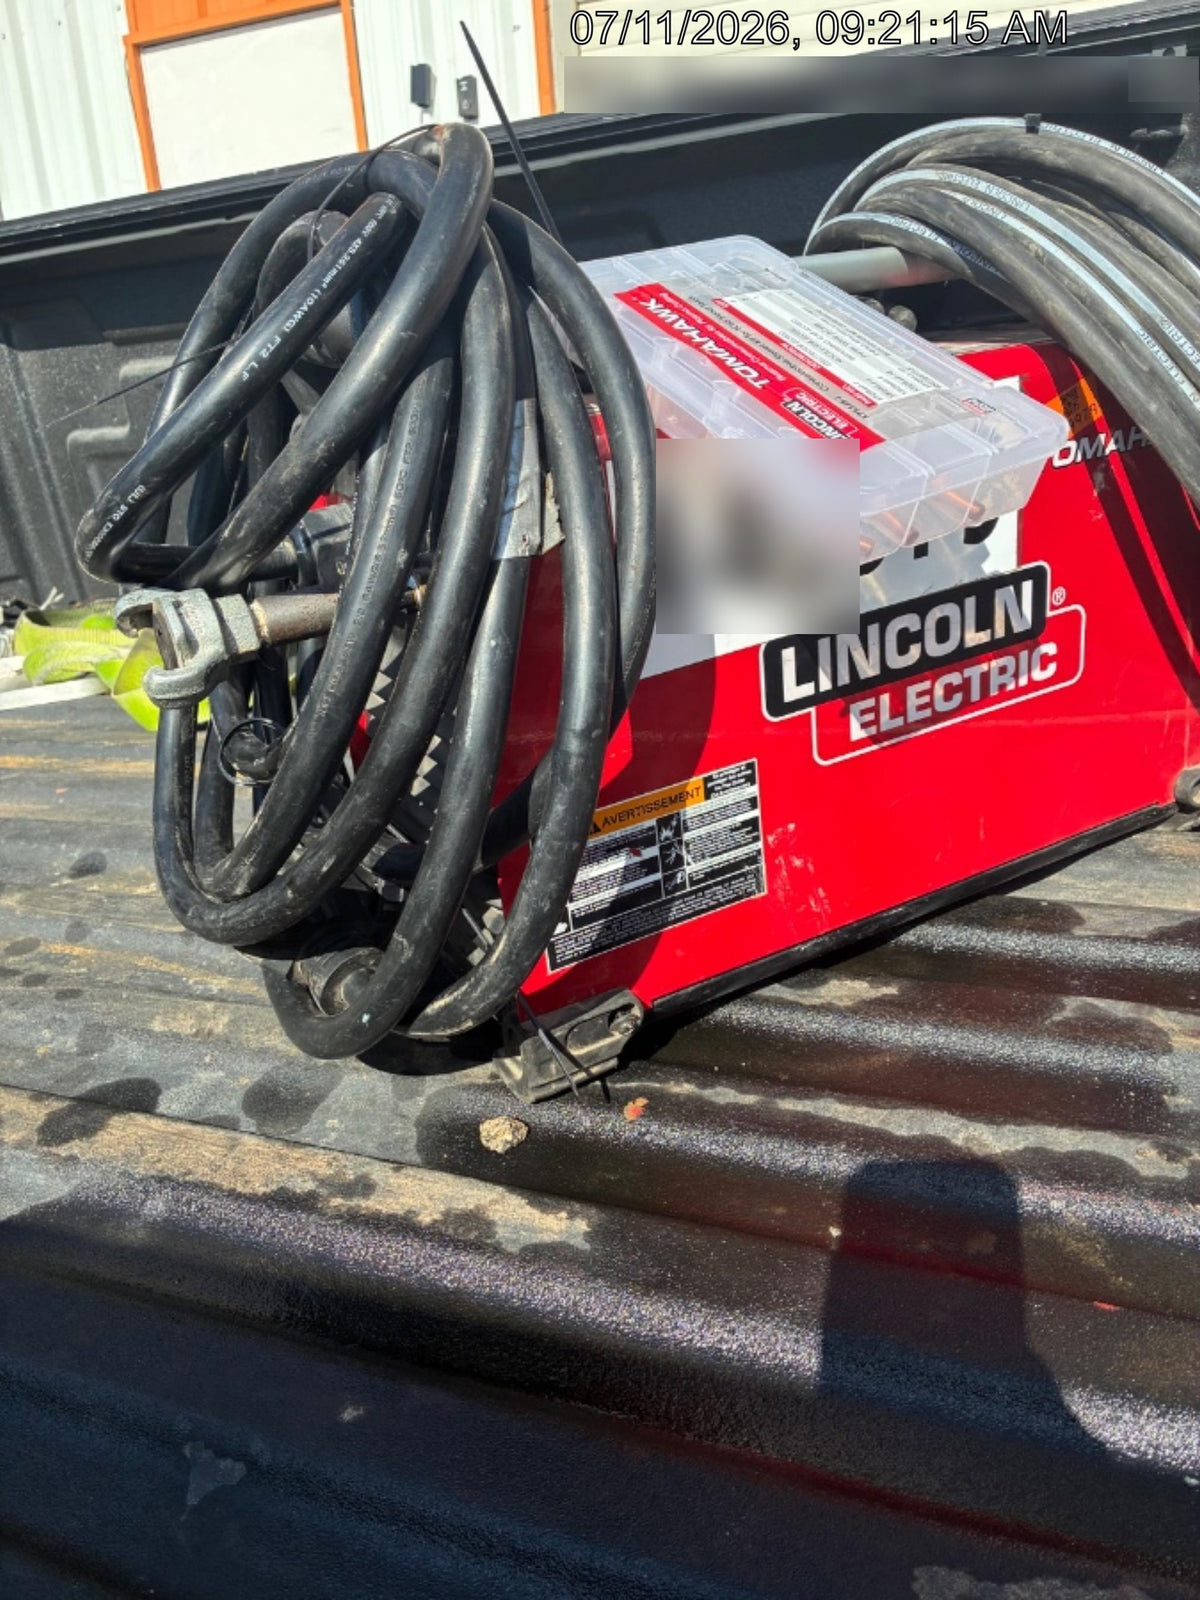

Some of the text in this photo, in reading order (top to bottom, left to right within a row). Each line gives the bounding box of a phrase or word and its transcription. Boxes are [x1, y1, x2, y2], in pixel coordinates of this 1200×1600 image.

[639, 298, 771, 389] TOMAHAWK
[783, 400, 848, 439] INCOLN
[796, 391, 849, 429] ELECTRIC
[1052, 426, 1155, 468] OMAH
[781, 579, 1034, 704] LINCOLN
[849, 641, 1058, 743] ELECTRIC
[602, 787, 702, 829] AVERTISSEMENT
